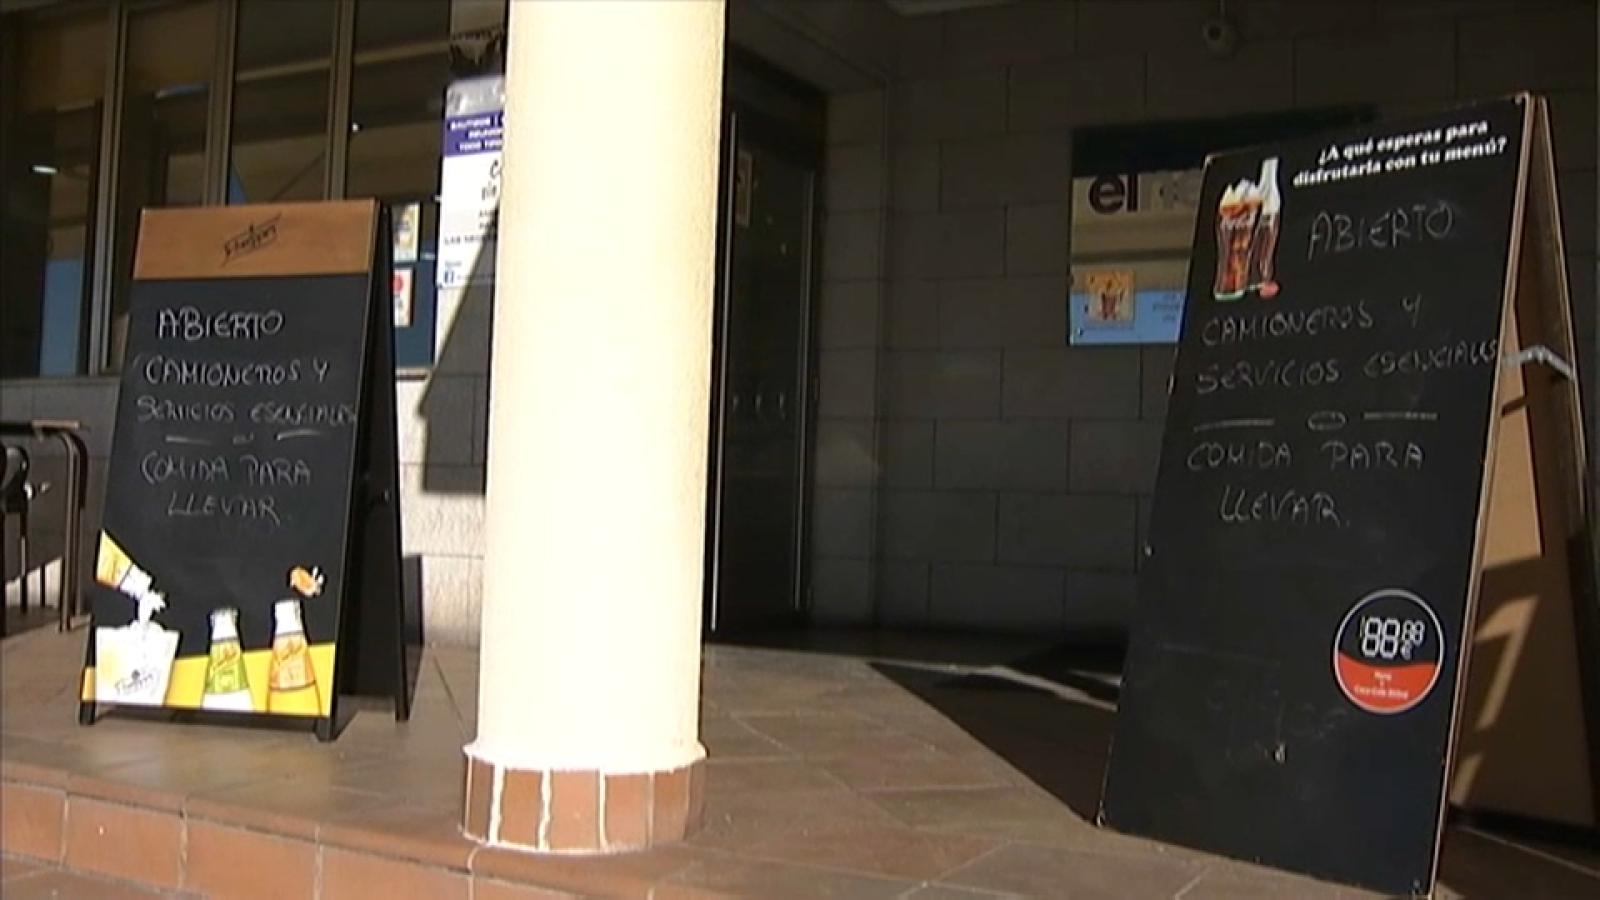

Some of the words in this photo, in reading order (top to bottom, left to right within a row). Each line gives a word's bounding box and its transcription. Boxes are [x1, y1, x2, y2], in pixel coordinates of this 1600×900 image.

[1318, 144, 1339, 165] ¿A
[1343, 137, 1374, 159] qué
[1377, 127, 1441, 153] esperas
[1445, 120, 1489, 143] para
[1293, 159, 1382, 187] disfrutarla
[1386, 150, 1417, 172] con
[1420, 146, 1441, 166] tu
[1445, 136, 1508, 161] menú?
[1308, 202, 1454, 261] ABIERTO
[157, 306, 283, 341] ABIERTO
[1201, 301, 1373, 346] CAMIONEROS
[145, 355, 301, 387] CAMIONEROS
[312, 358, 330, 383] Y
[1194, 359, 1340, 394] SERVICIOS
[136, 394, 235, 422] SERVICIOS
[140, 451, 230, 485] COMIDA
[240, 454, 312, 486] PARA
[1186, 441, 1292, 470] COMIDA
[1321, 440, 1424, 470] PARA
[167, 491, 281, 528] LLEVAR
